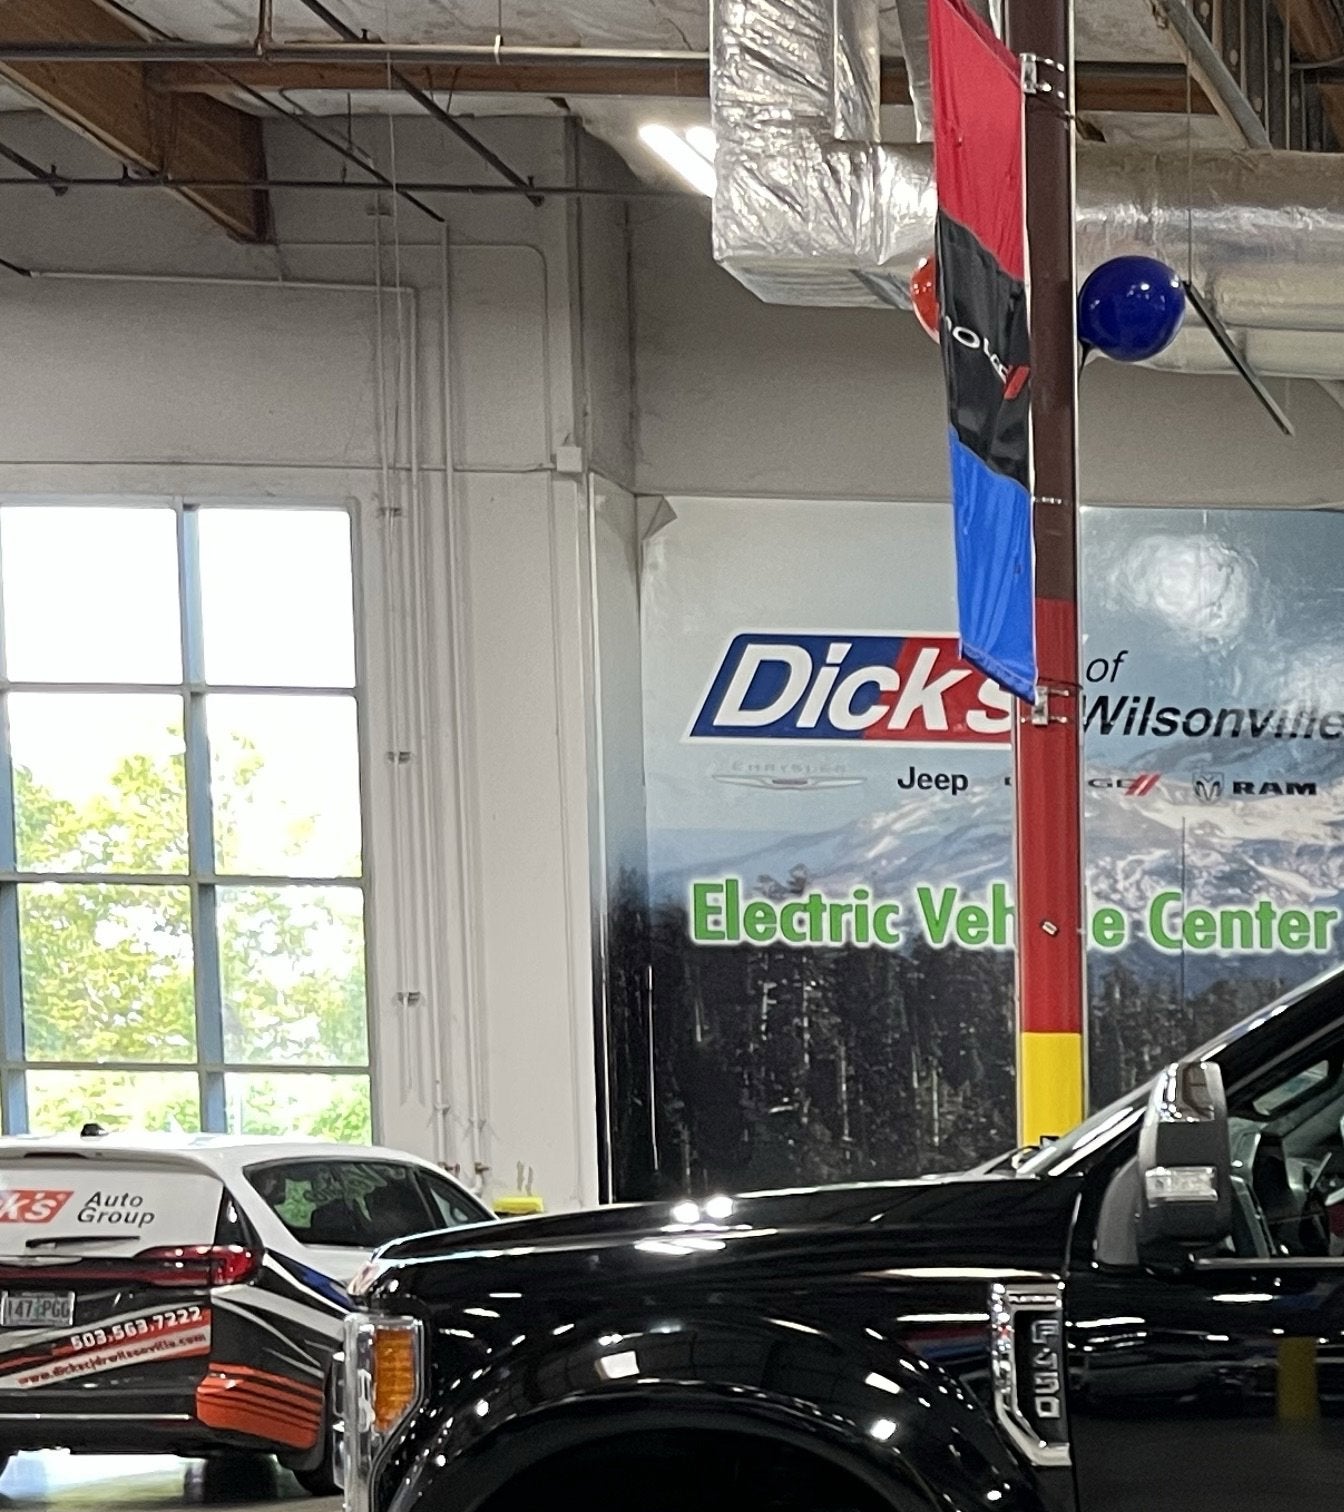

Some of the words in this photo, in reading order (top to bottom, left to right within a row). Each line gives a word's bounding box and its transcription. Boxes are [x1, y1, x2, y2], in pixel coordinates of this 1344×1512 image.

[1086, 650, 1128, 683] of
[711, 643, 1012, 734] Dicks
[897, 766, 969, 796] Jeep
[1232, 781, 1318, 796] RAM
[693, 879, 901, 944] Electric
[917, 883, 1126, 948] Vehe
[1149, 891, 1339, 949] Center
[84, 1191, 144, 1208] Auto
[77, 1207, 156, 1228] Group
